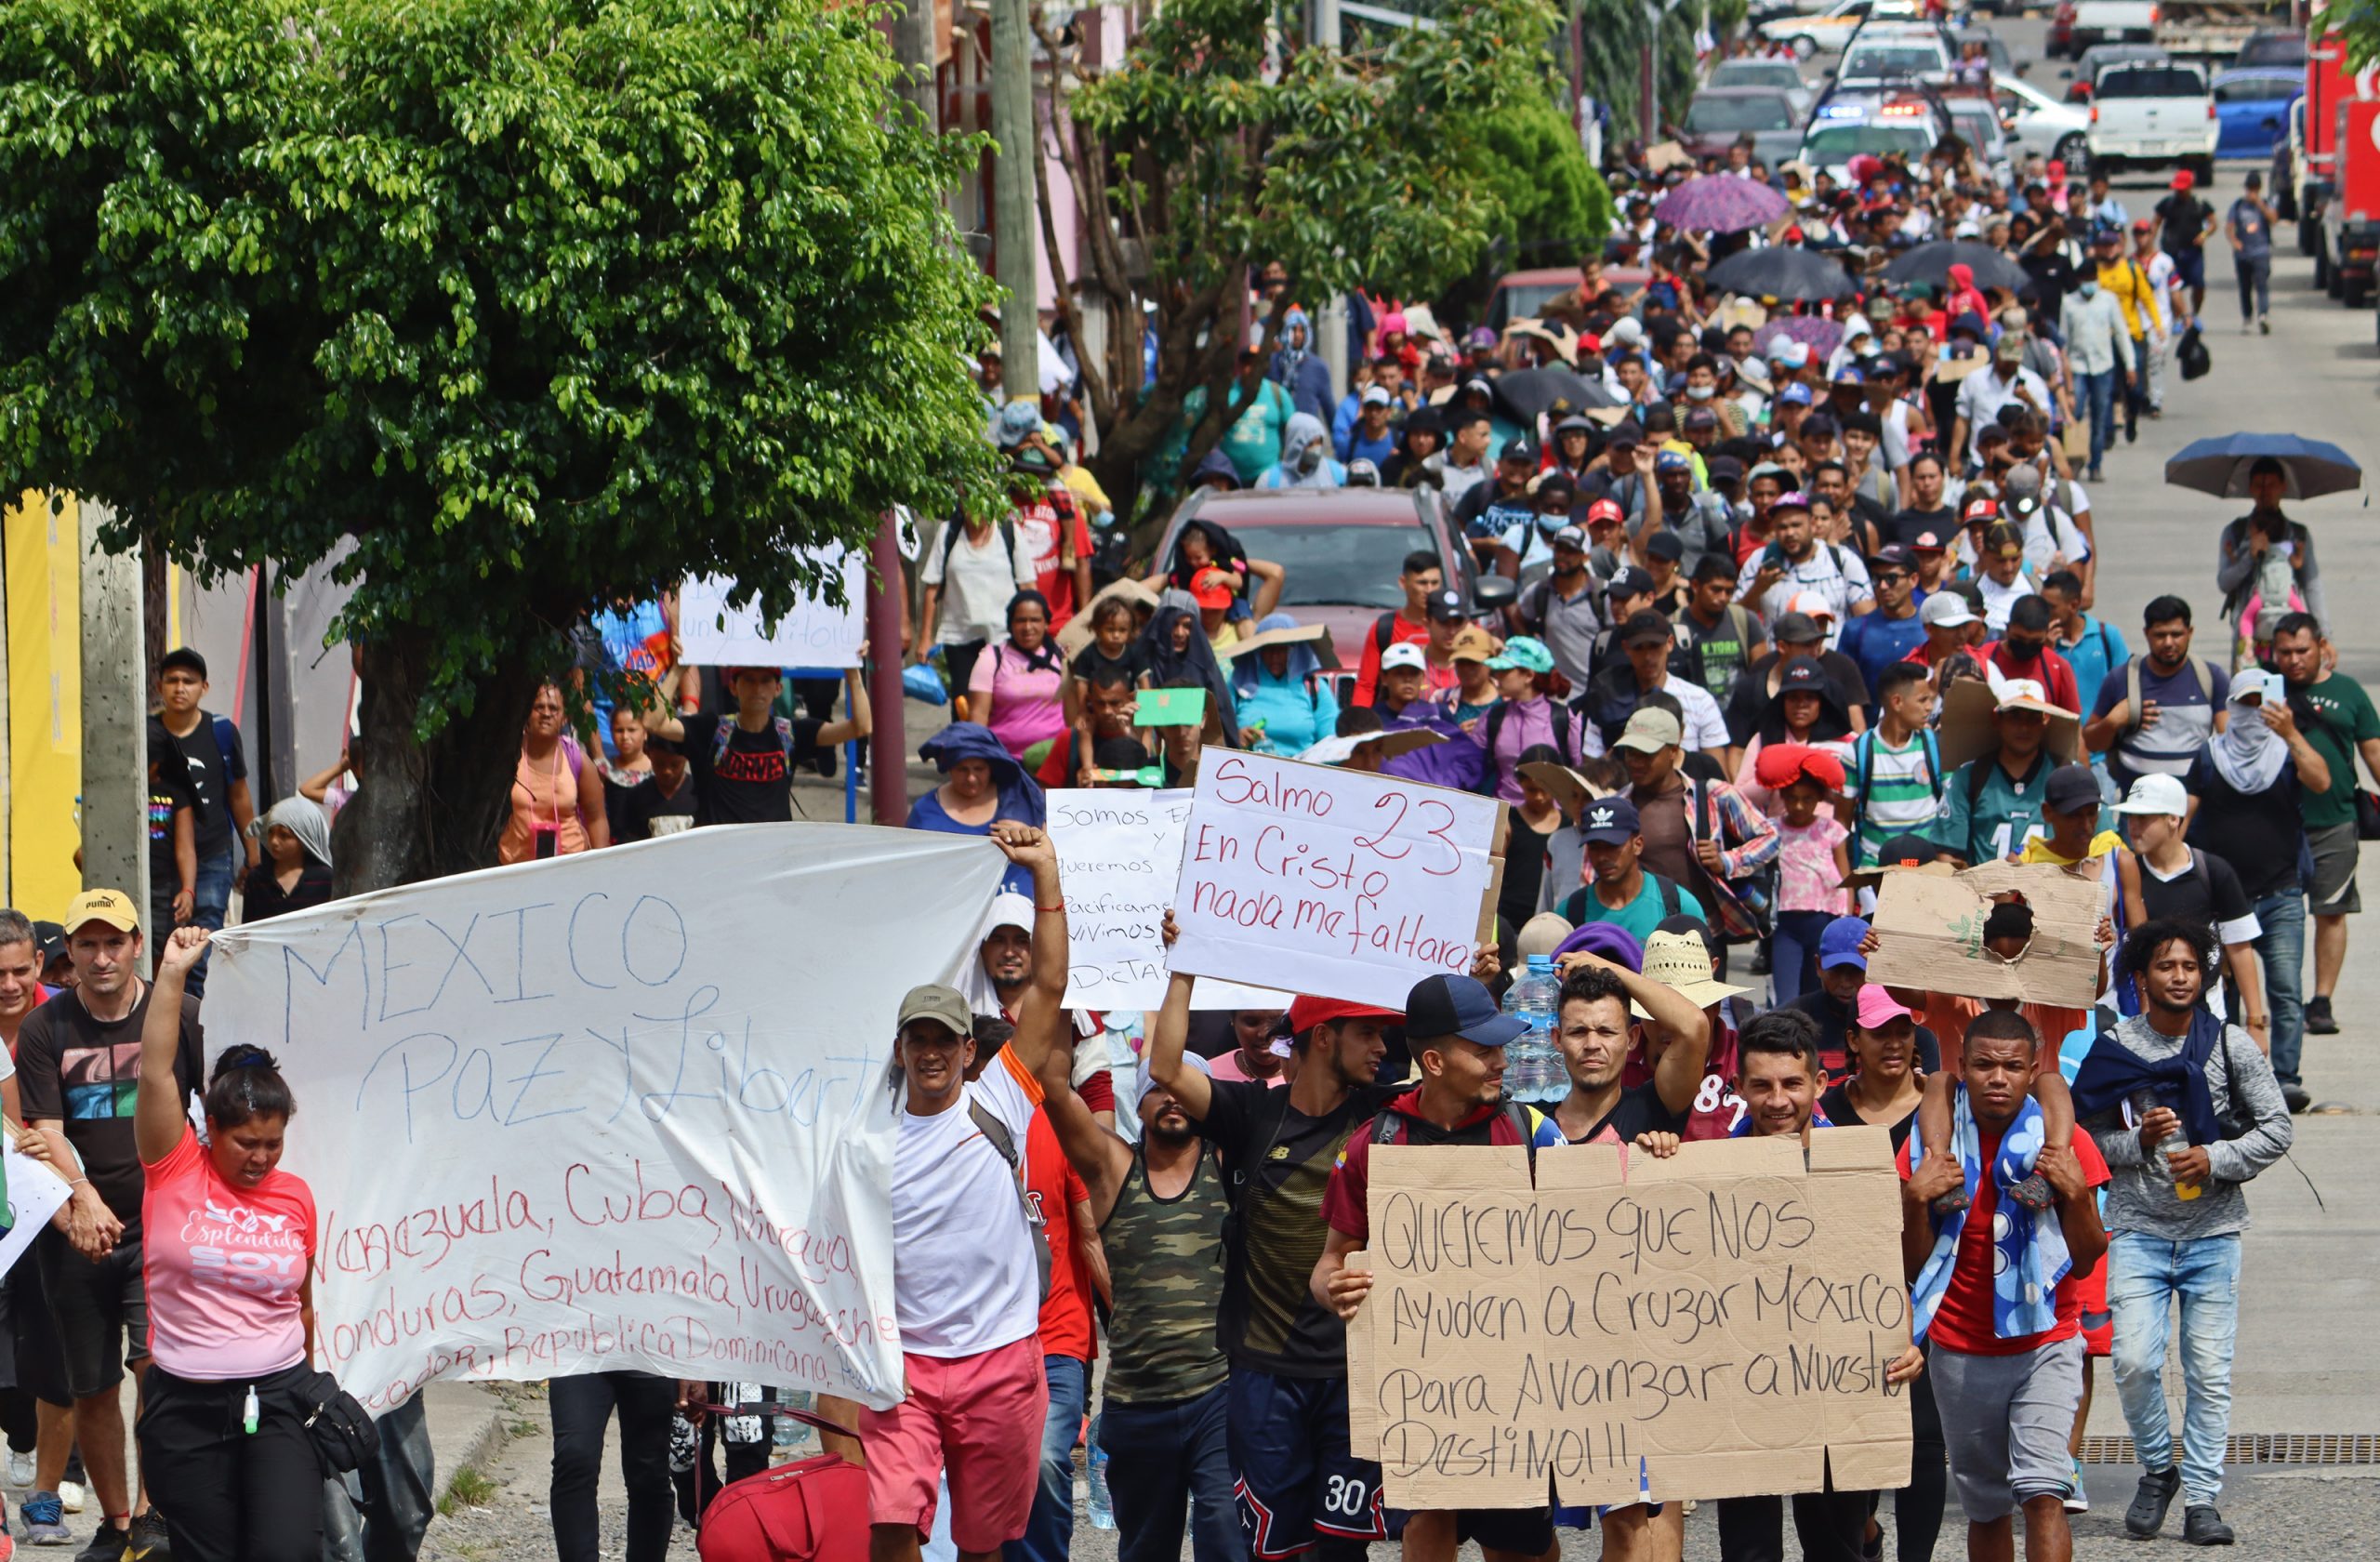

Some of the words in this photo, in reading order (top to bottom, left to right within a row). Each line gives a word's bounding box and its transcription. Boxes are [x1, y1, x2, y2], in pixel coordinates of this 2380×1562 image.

[1052, 803, 1149, 828] Somos
[1215, 758, 1333, 816] Salmo
[1353, 791, 1462, 876] 23
[1194, 823, 1238, 863] En
[1254, 825, 1389, 897] Cristo
[1193, 880, 1283, 930] nada
[1347, 894, 1470, 976] faltara
[282, 891, 688, 1044] MEXICO
[1693, 1073, 1748, 1132] 87
[564, 1158, 721, 1250] Cuba,
[189, 1244, 298, 1275] SOY
[1393, 1286, 1527, 1358] Ayuden
[1544, 1285, 1580, 1339] a
[1593, 1271, 1741, 1344] Cruzar
[1744, 1353, 1783, 1396] a
[1325, 1474, 1367, 1516] 30
